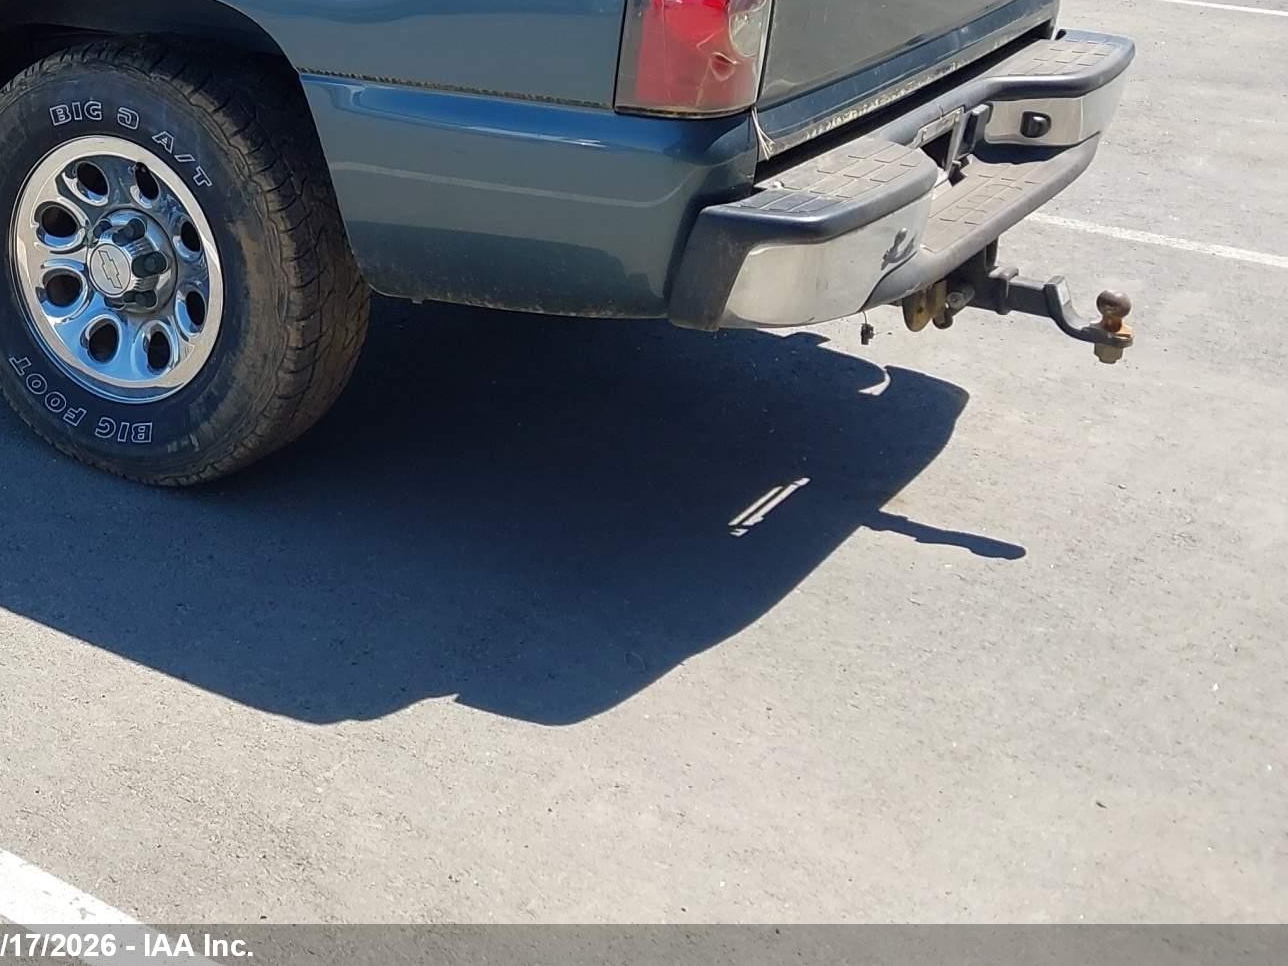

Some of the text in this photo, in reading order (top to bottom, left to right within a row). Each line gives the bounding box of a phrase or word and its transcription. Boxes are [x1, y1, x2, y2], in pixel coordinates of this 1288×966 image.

[49, 100, 103, 126] BIG
[151, 130, 213, 187] A/T
[8, 356, 153, 443] BIG FOOT
